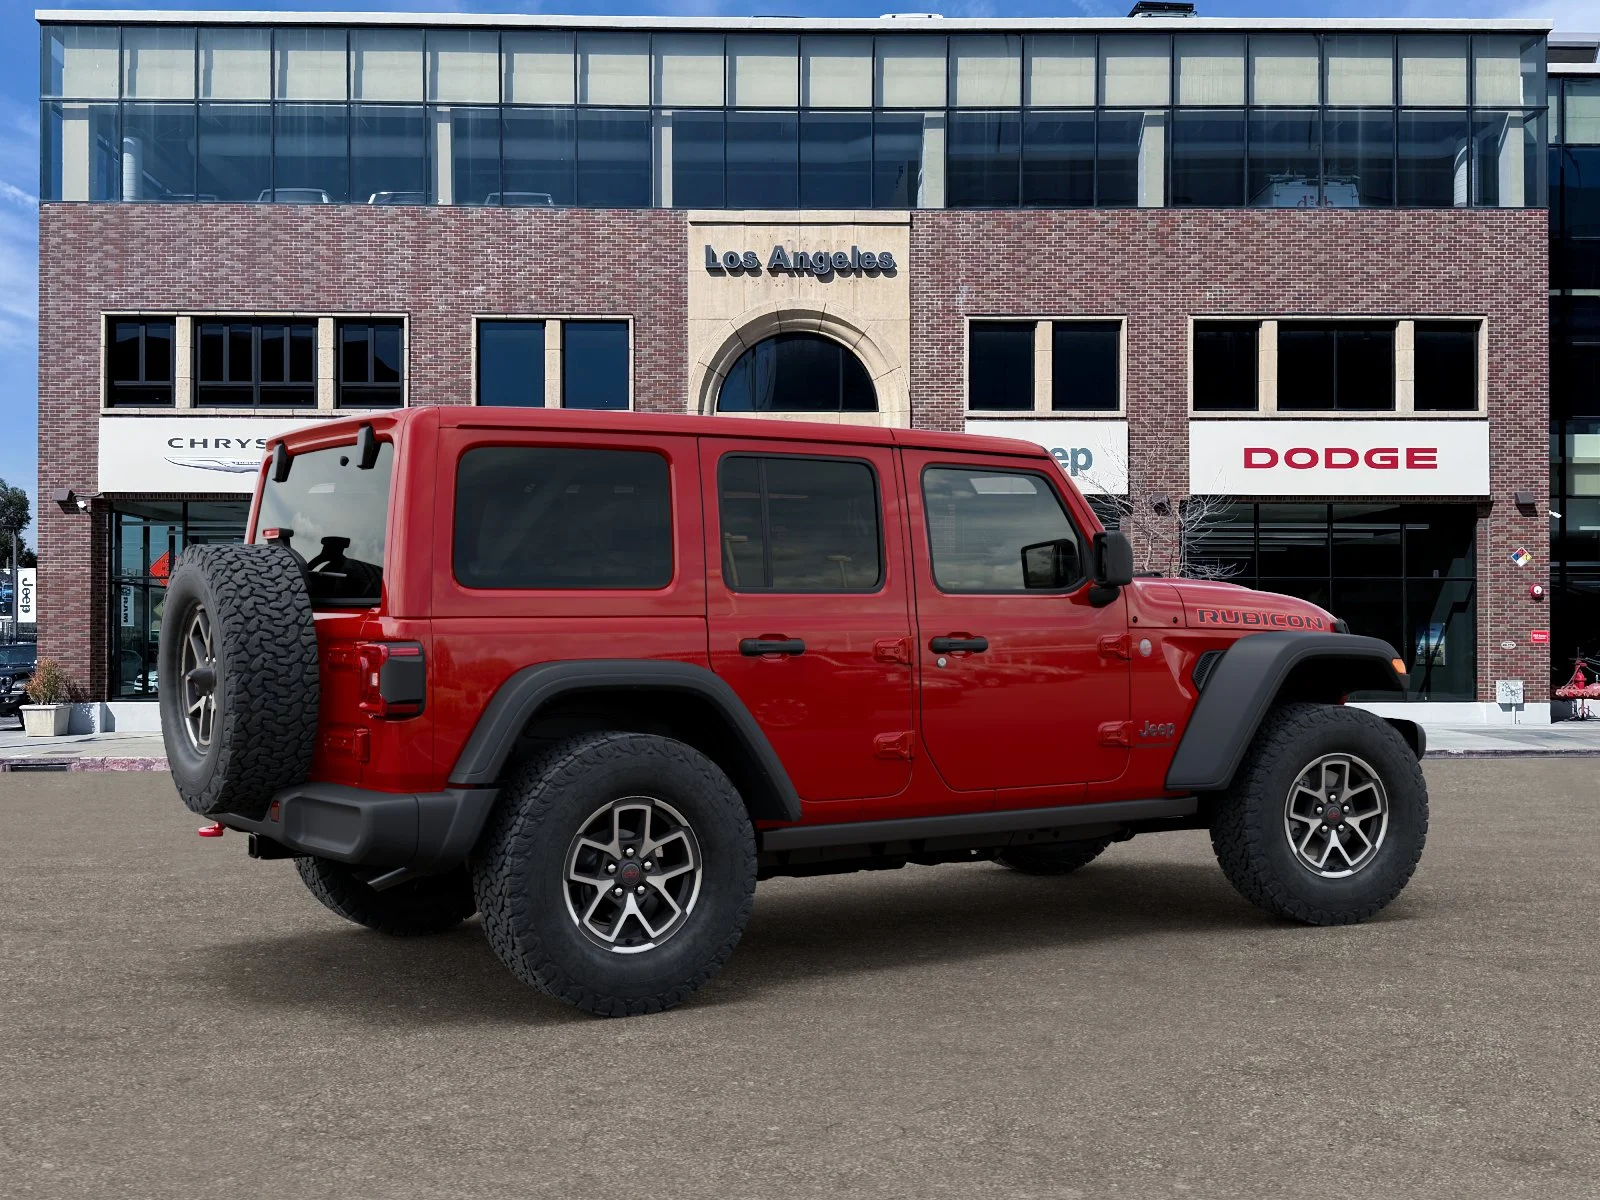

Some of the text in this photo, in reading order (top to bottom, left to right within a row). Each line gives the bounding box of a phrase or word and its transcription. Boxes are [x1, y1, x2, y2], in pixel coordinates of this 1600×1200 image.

[1297, 195, 1334, 208] dih
[704, 244, 896, 275] Los Angeles
[167, 437, 266, 449] CHRYS
[1050, 447, 1093, 477] ep
[1243, 447, 1438, 469] DODGE
[20, 577, 34, 614] Jeep
[1197, 608, 1325, 631] RUBICON
[1139, 720, 1175, 739] Jeep
